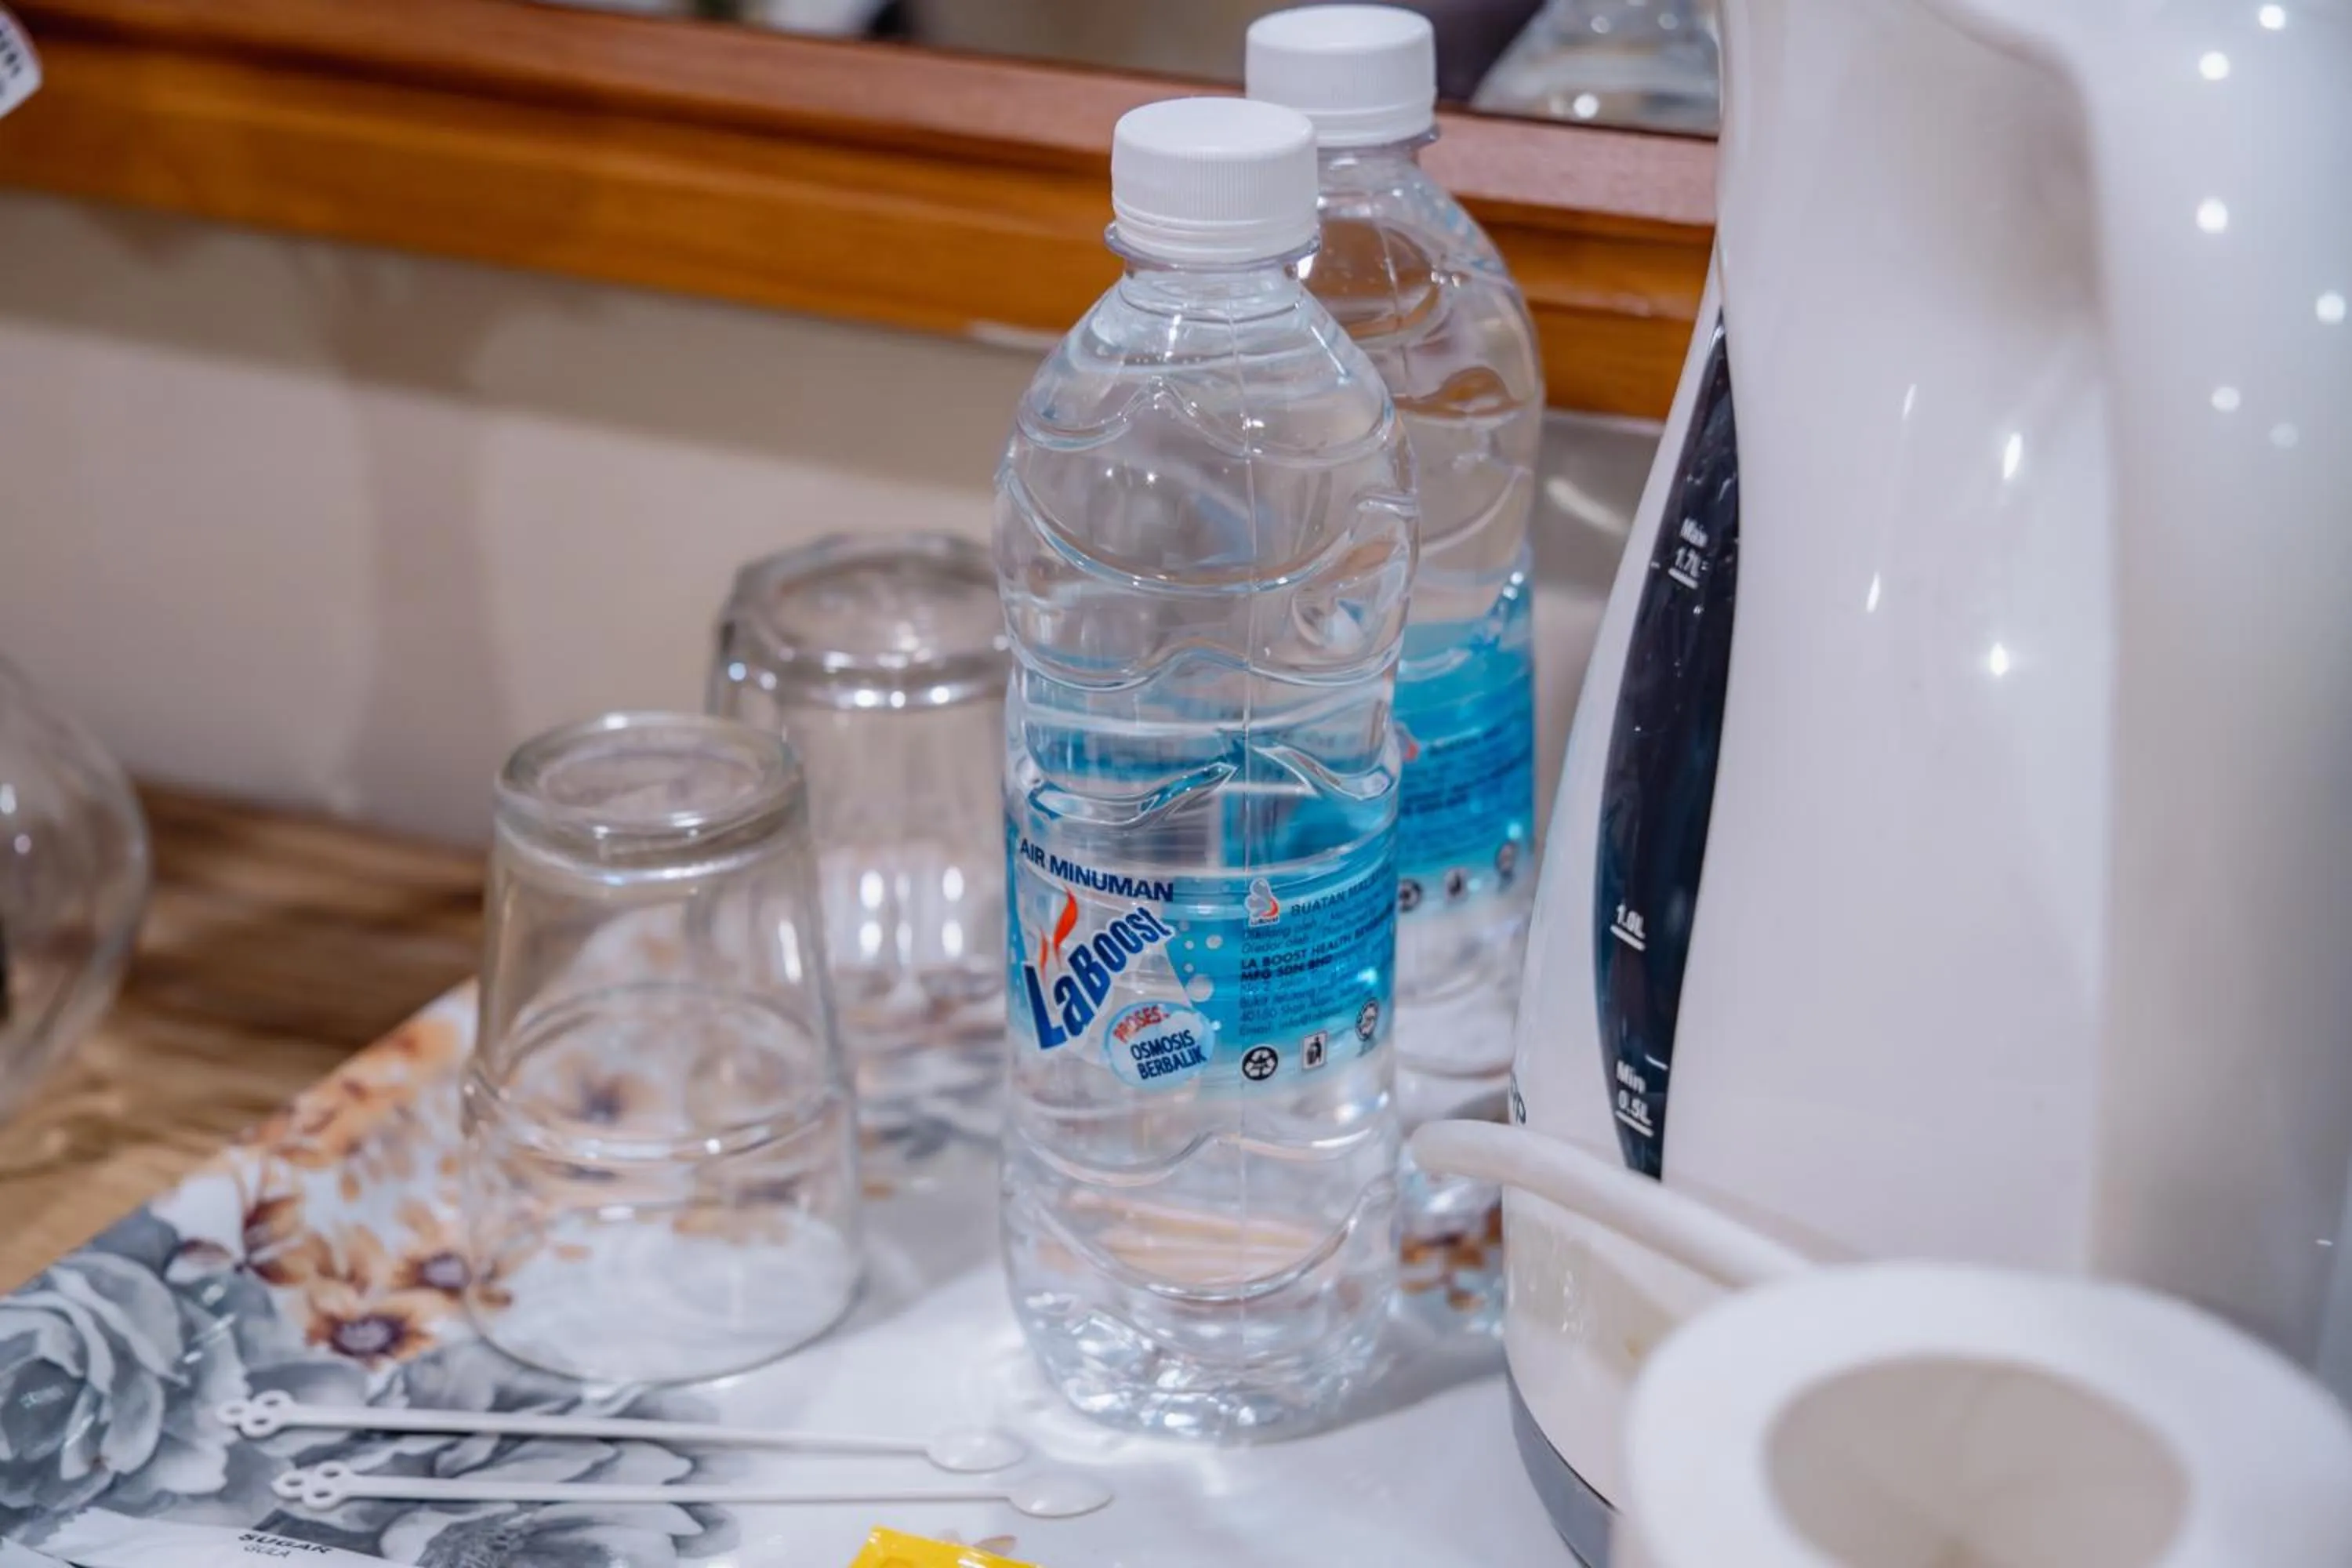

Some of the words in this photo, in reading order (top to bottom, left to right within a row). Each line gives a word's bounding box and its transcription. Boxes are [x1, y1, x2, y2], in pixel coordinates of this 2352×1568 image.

[1021, 838, 1045, 869] AIR
[1050, 855, 1174, 902] MINUMAN
[1291, 891, 1345, 916] BUATAN
[1617, 903, 1646, 939] 1.0L
[1240, 968, 1272, 981] MFG
[1241, 958, 1258, 970] LA
[1261, 949, 1307, 967] BOOST
[1024, 906, 1172, 1050] LaBoost
[1130, 1029, 1196, 1061] OSMOSIS
[1137, 1045, 1208, 1080] BERBALIK
[1616, 1059, 1646, 1094] Min
[1618, 1090, 1653, 1127] 0.5L
[238, 1534, 332, 1553] SUGAR
